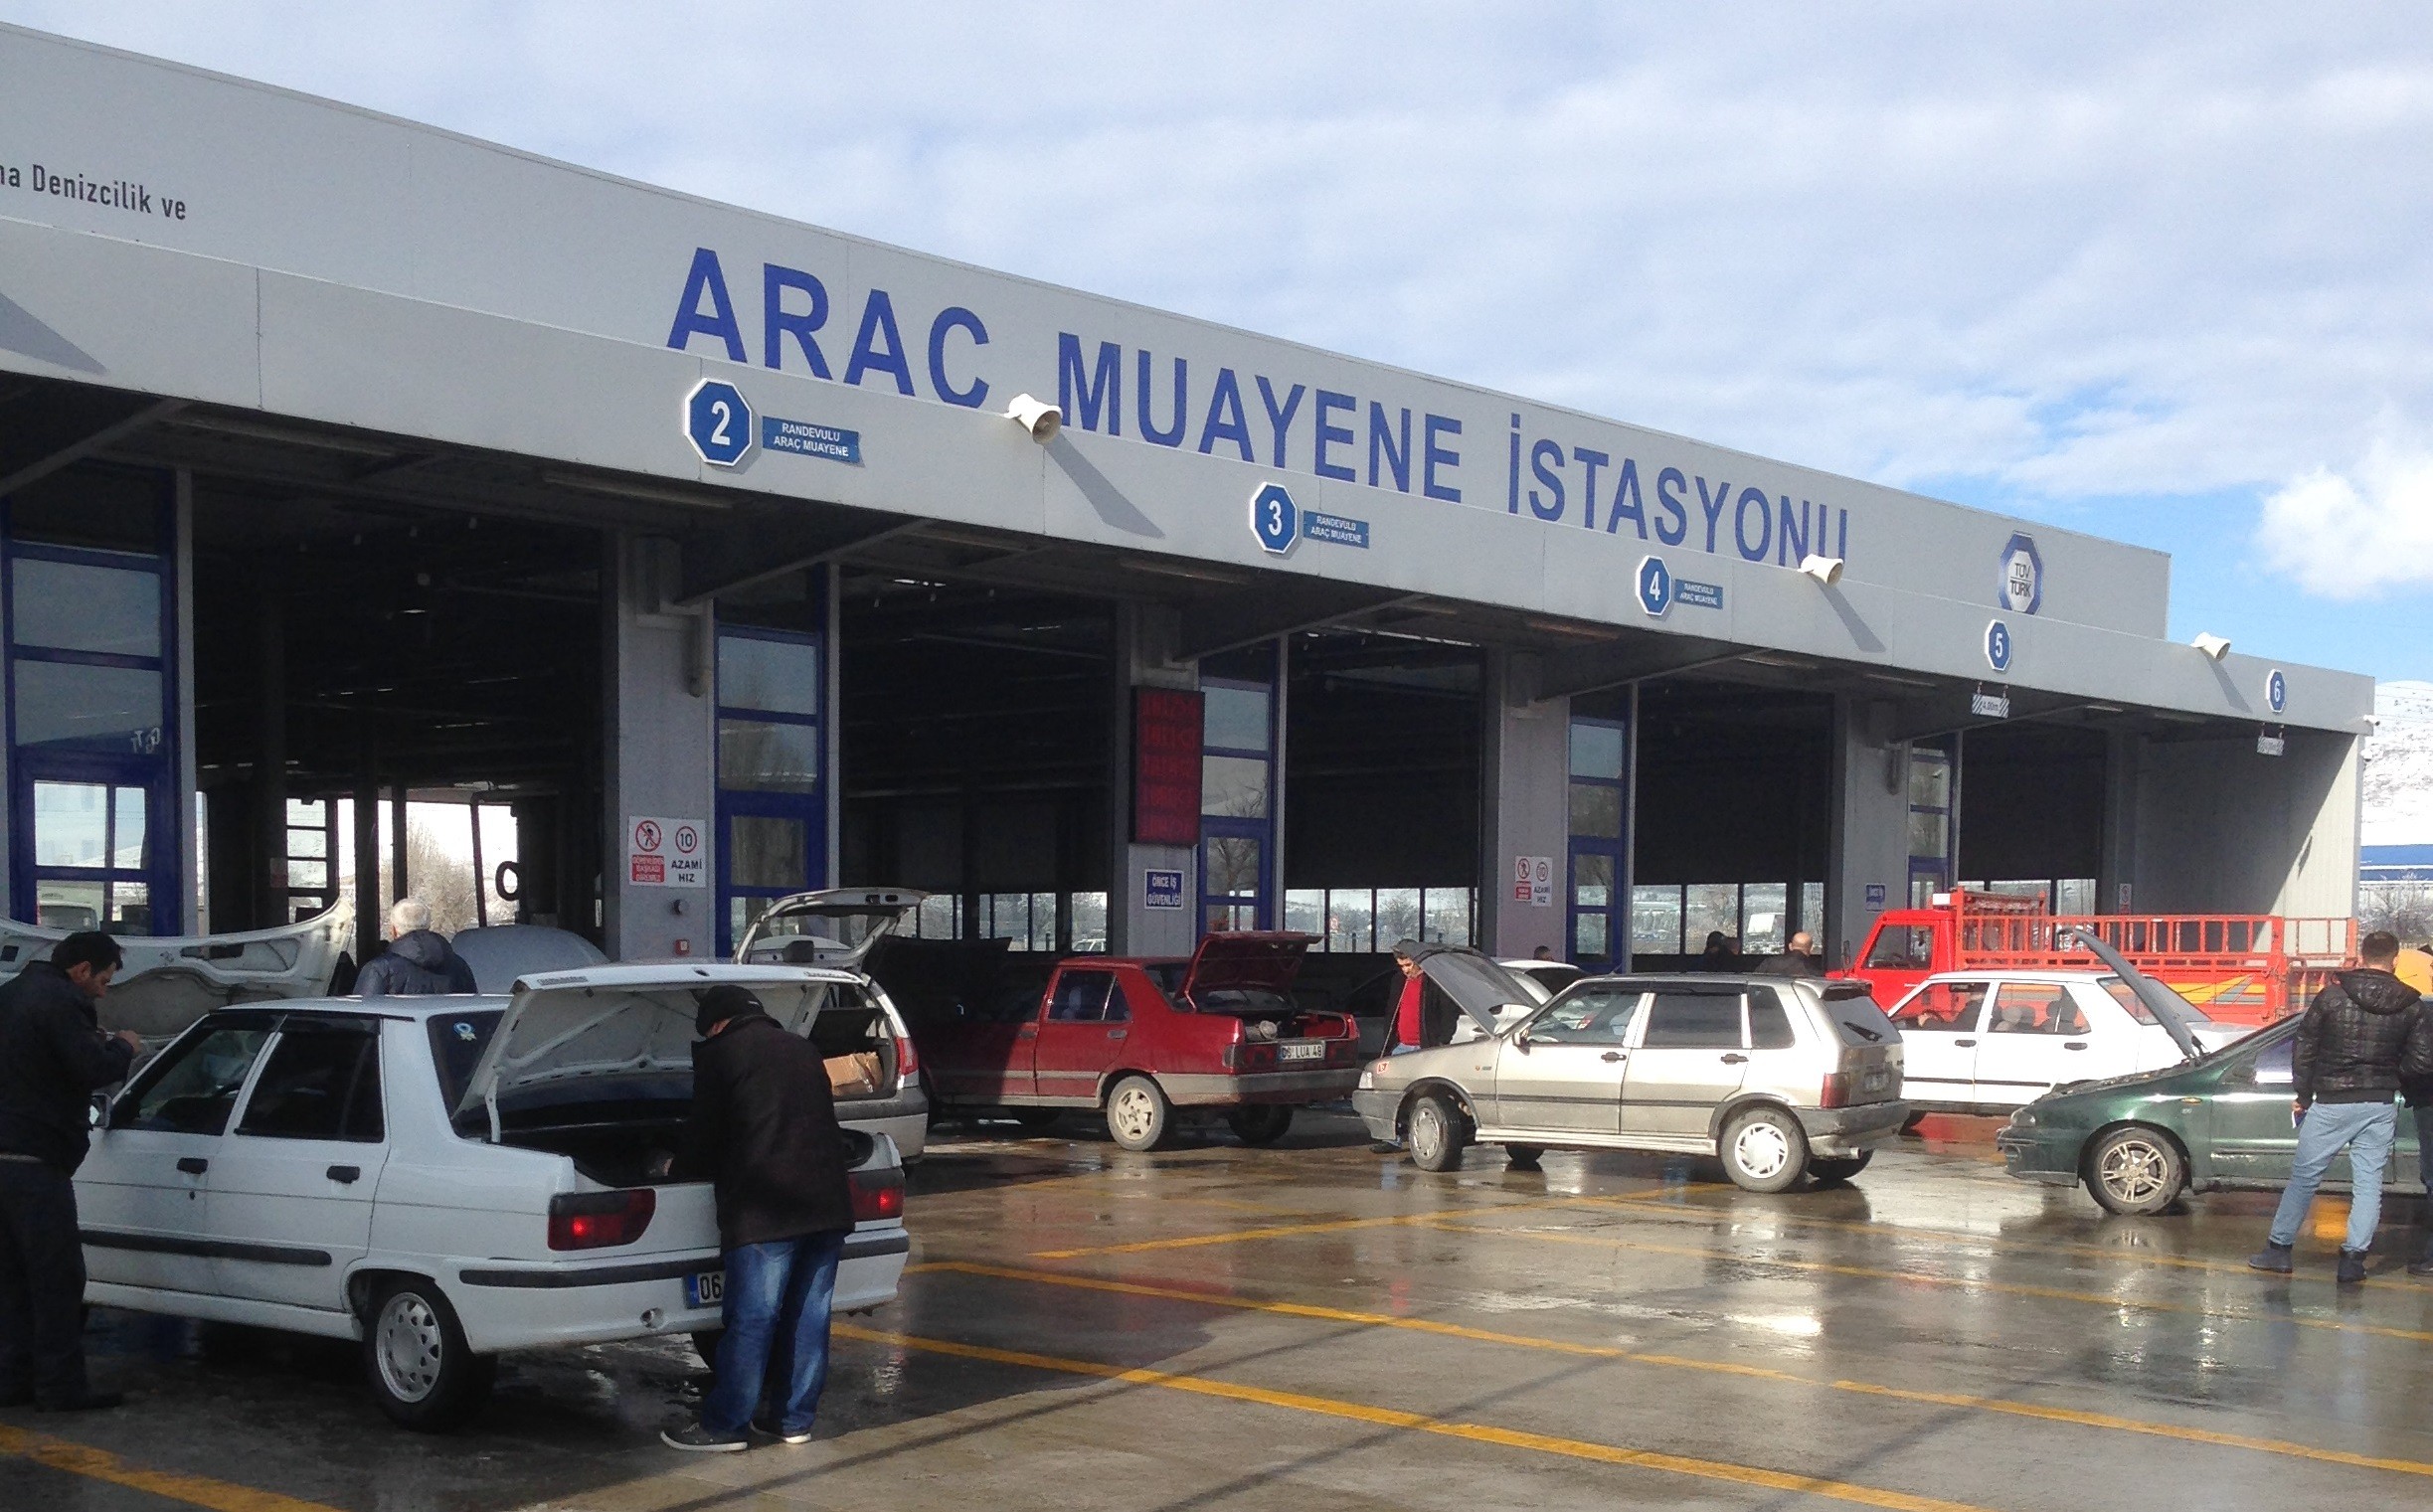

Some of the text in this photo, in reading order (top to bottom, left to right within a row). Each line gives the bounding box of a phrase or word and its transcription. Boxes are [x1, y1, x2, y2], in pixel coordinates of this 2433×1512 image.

[33, 164, 151, 214] Denizcilik
[162, 198, 186, 221] ve
[711, 401, 731, 445] 2
[1059, 332, 1462, 503] MUAYENE
[782, 422, 840, 441] RANDEVULU
[774, 435, 849, 457] ARAÇ MUAYENE
[1268, 500, 1283, 536] 3
[1649, 570, 1660, 601] 4
[1995, 632, 2003, 658] 5
[2274, 680, 2281, 703] 6
[680, 833, 693, 847] 10
[671, 859, 702, 870] AZAMİ
[678, 873, 695, 883] HIZ
[699, 1274, 722, 1300] 06
